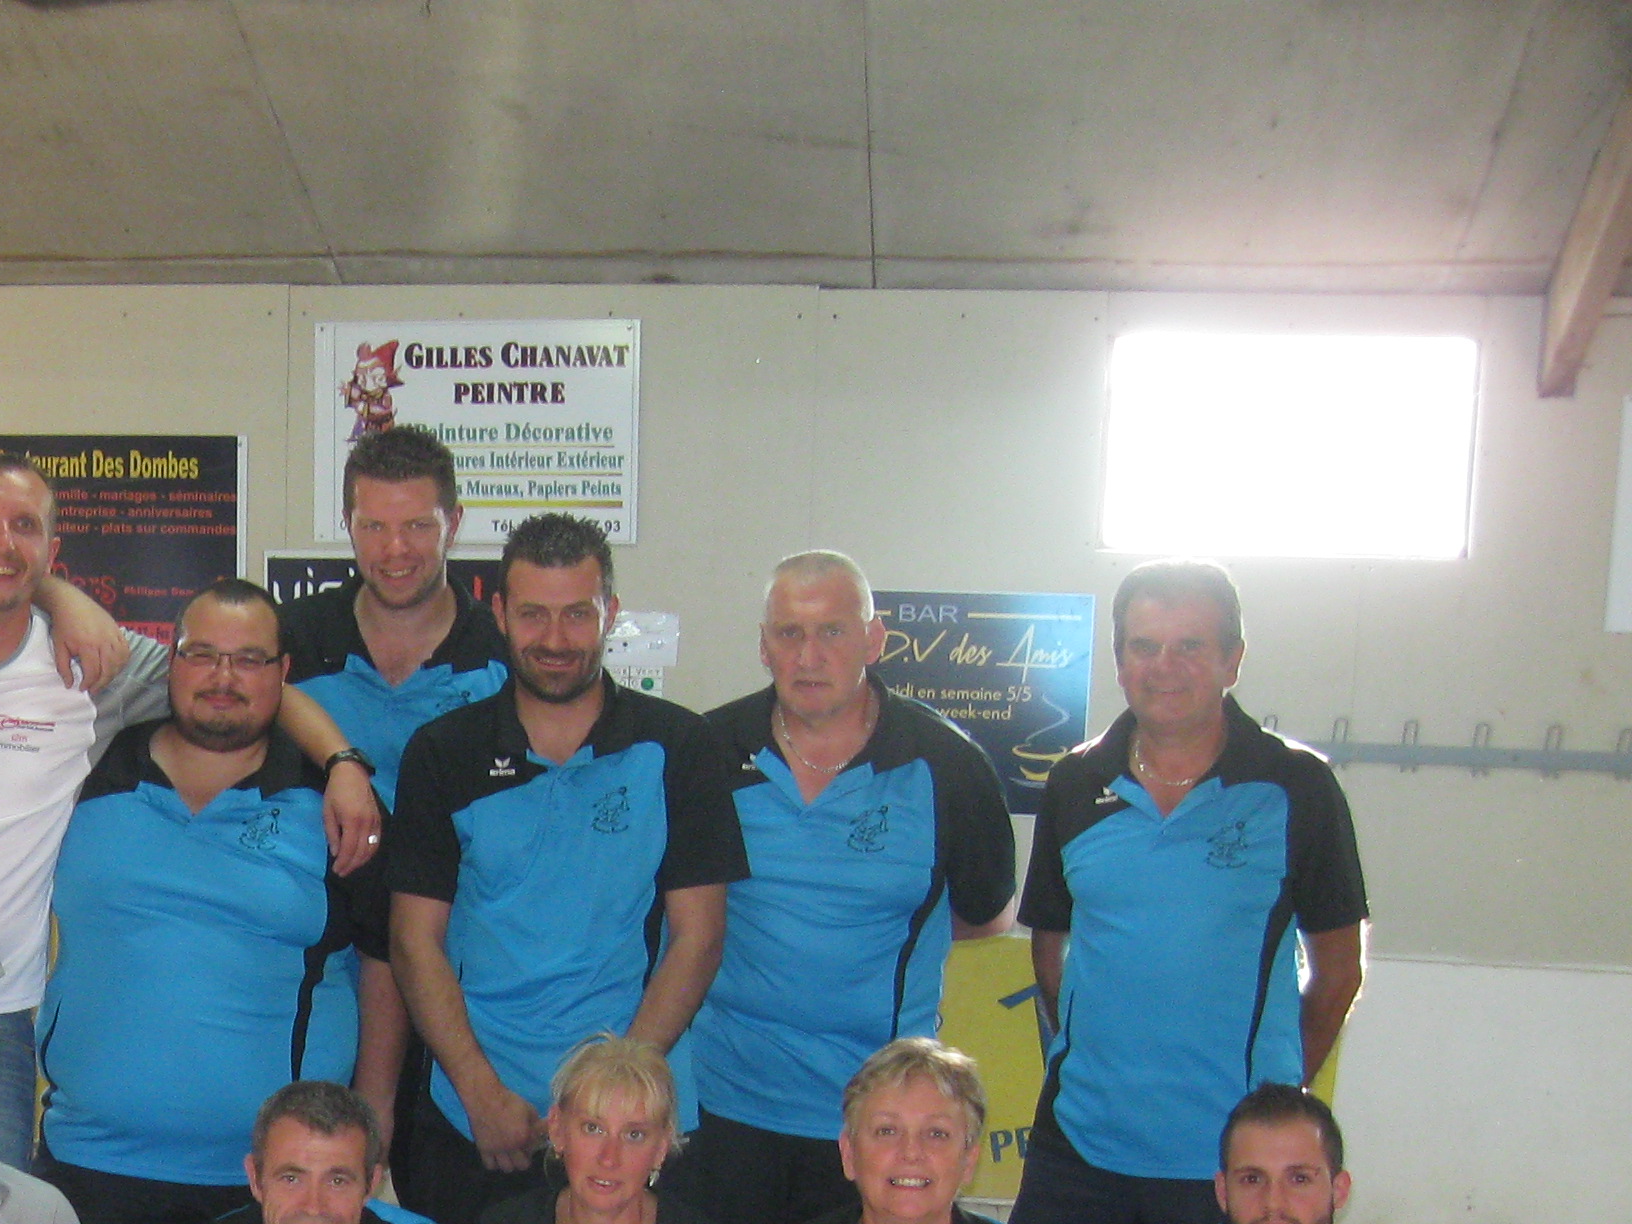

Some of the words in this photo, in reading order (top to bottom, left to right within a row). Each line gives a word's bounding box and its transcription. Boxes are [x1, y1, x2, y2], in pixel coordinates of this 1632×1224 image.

[405, 342, 493, 369] GILLES
[501, 341, 628, 368] CHANAVAT
[454, 381, 565, 405] PEINTRE
[505, 422, 613, 442] Décorative
[92, 449, 125, 478] Des
[130, 450, 199, 479] Dombes
[490, 451, 552, 469] Intérieur
[557, 451, 624, 470] Extérieur
[528, 480, 577, 500] Papiers
[581, 480, 622, 497] Peints
[60, 506, 116, 519] ntreprise
[128, 505, 213, 518] anniversaires
[101, 522, 132, 535] plats
[136, 525, 156, 534] sur
[160, 523, 235, 535] commandes
[898, 604, 959, 624] BAR
[949, 633, 992, 666] des
[996, 624, 1074, 683] Amis
[918, 687, 935, 700] en
[940, 686, 1002, 701] semaine
[1006, 685, 1033, 703] 5/5
